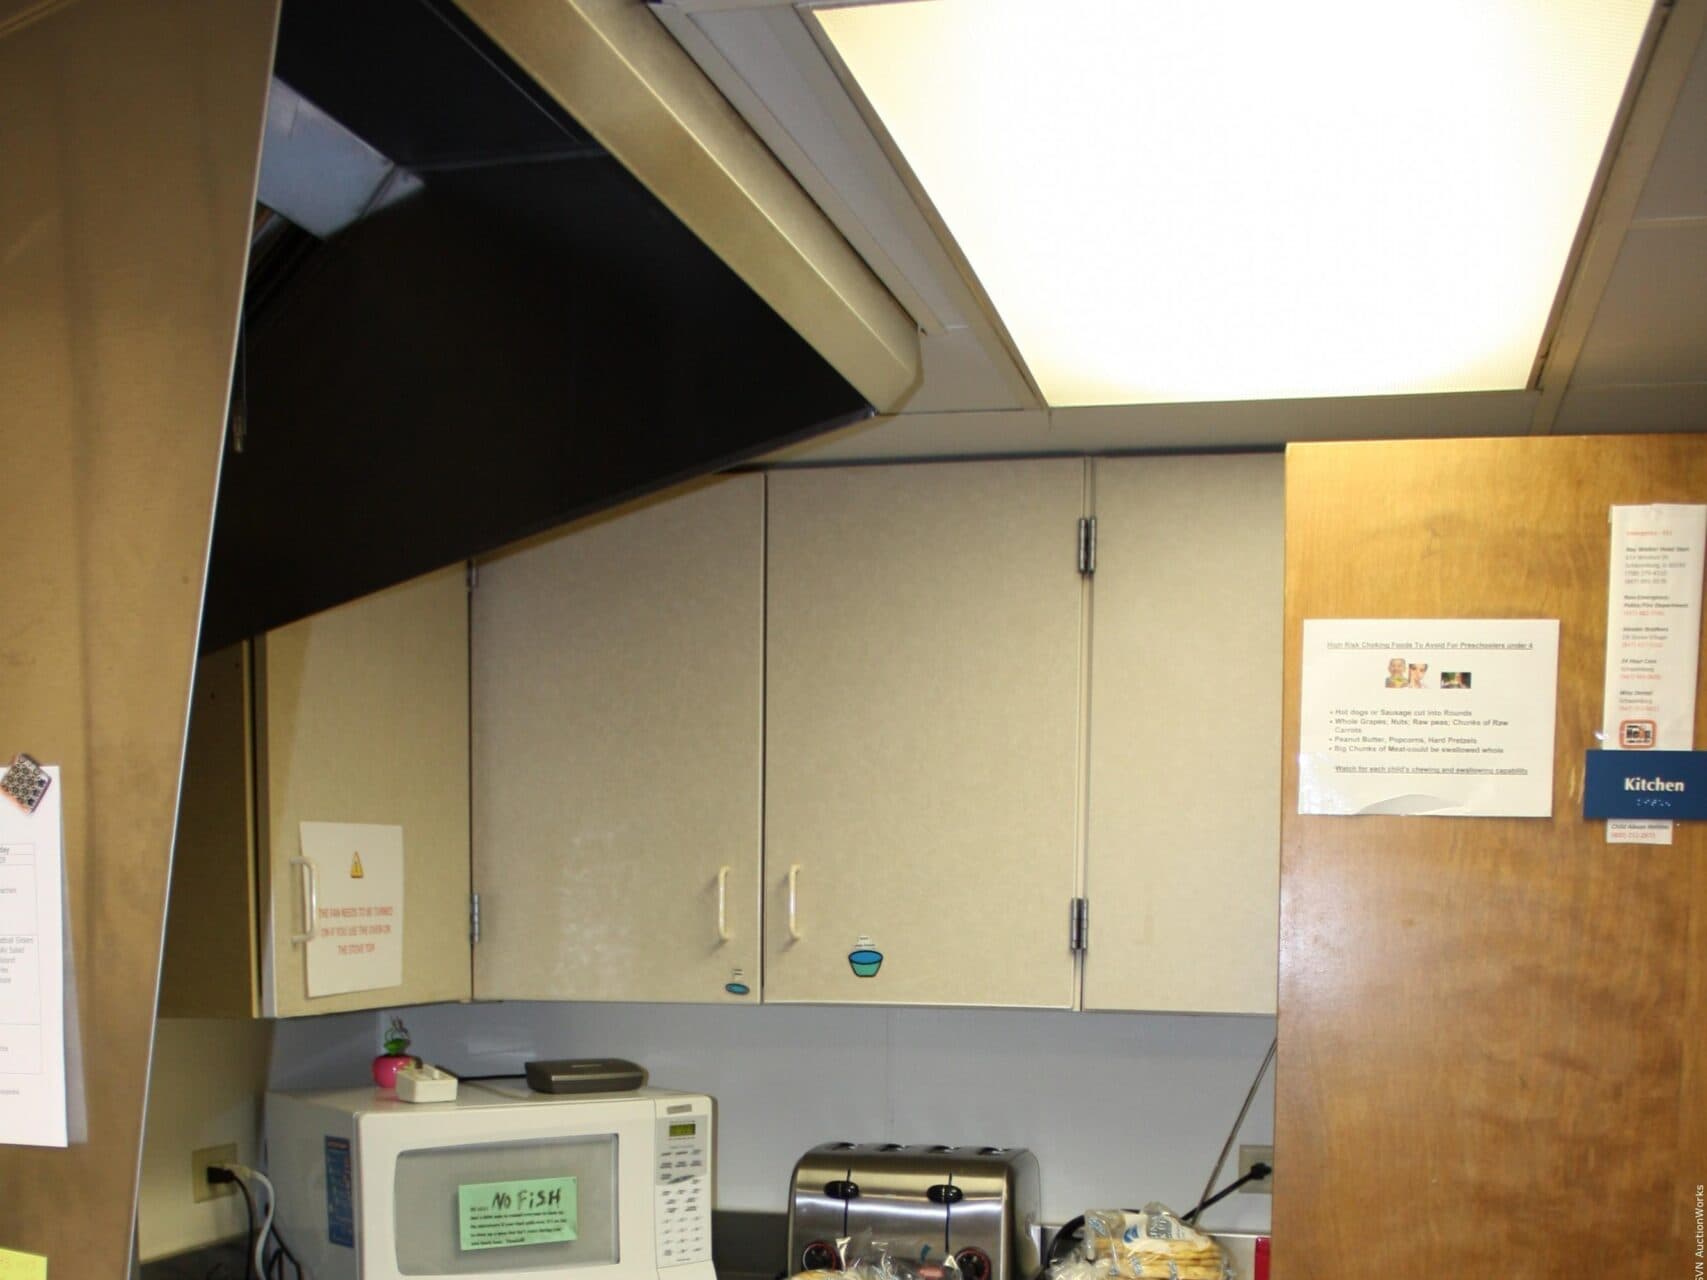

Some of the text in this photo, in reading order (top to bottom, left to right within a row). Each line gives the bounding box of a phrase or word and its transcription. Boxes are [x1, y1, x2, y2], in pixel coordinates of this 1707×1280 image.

[1335, 709, 1348, 717] Hot
[1350, 709, 1368, 717] dogs
[1380, 709, 1412, 717] Sausage
[1428, 709, 1442, 717] into
[1444, 709, 1472, 717] Rounds
[1335, 718, 1358, 726] Whole
[1413, 719, 1428, 727] Raw
[1452, 719, 1480, 727] Chunks
[1492, 719, 1508, 727] Raw
[1334, 736, 1360, 744] Peanut
[1428, 736, 1446, 744] Hard
[1448, 736, 1477, 744] Pretzels
[1334, 745, 1347, 753] Big
[1349, 745, 1377, 753] Chunks
[1441, 746, 1480, 754] swallowed
[1482, 746, 1504, 754] whole
[1624, 776, 1685, 792] Kitchen
[492, 1191, 512, 1209] NO
